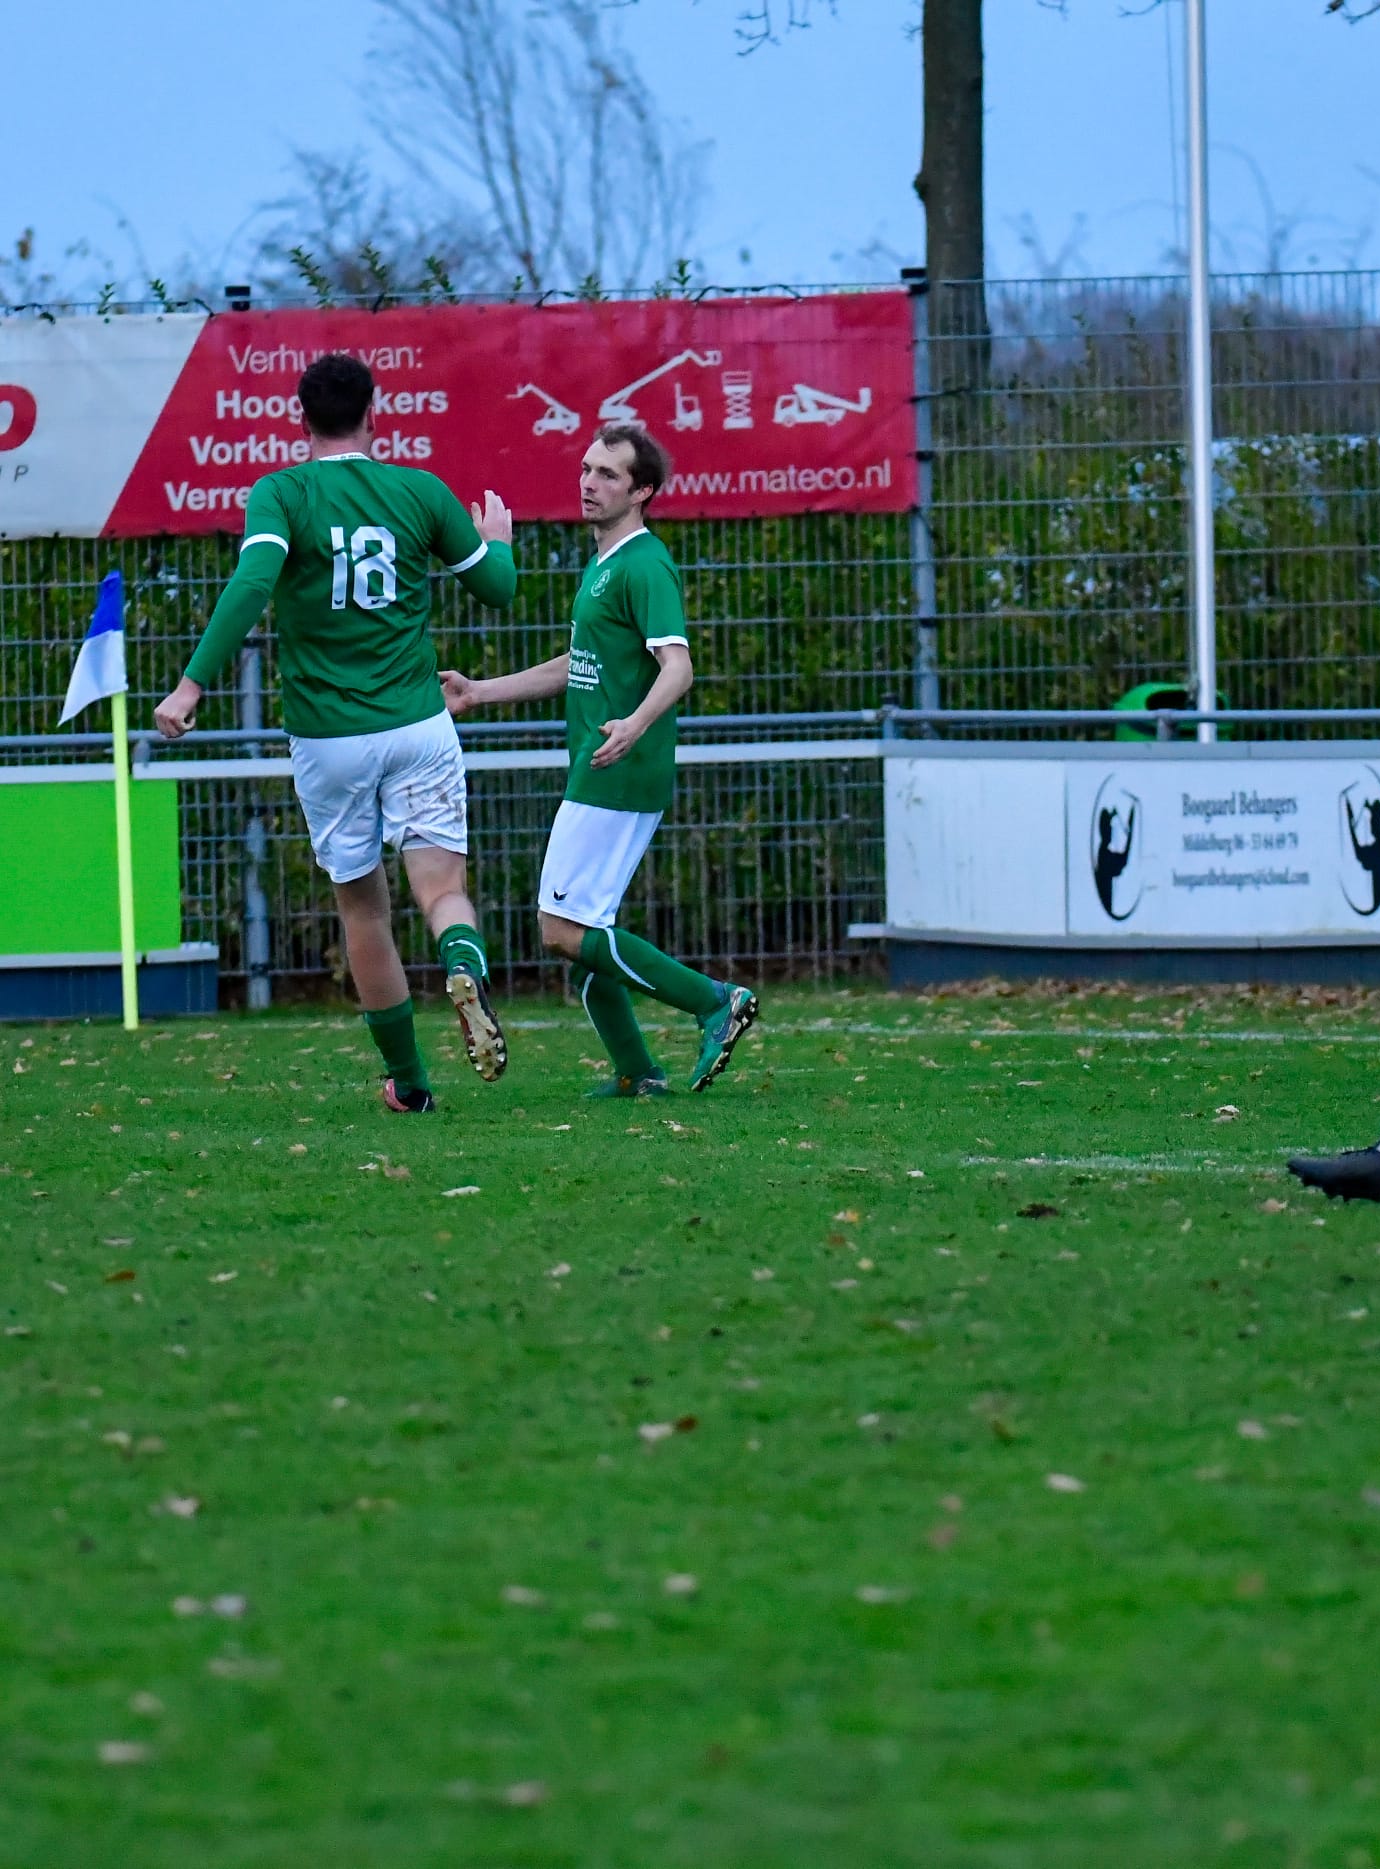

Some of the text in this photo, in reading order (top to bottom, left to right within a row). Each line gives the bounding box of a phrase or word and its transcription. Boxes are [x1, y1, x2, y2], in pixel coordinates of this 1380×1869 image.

[229, 344, 423, 374] Verhu van:
[216, 385, 449, 424] Hoogkers
[189, 429, 433, 465] Vorkhecks
[330, 526, 397, 610] 18
